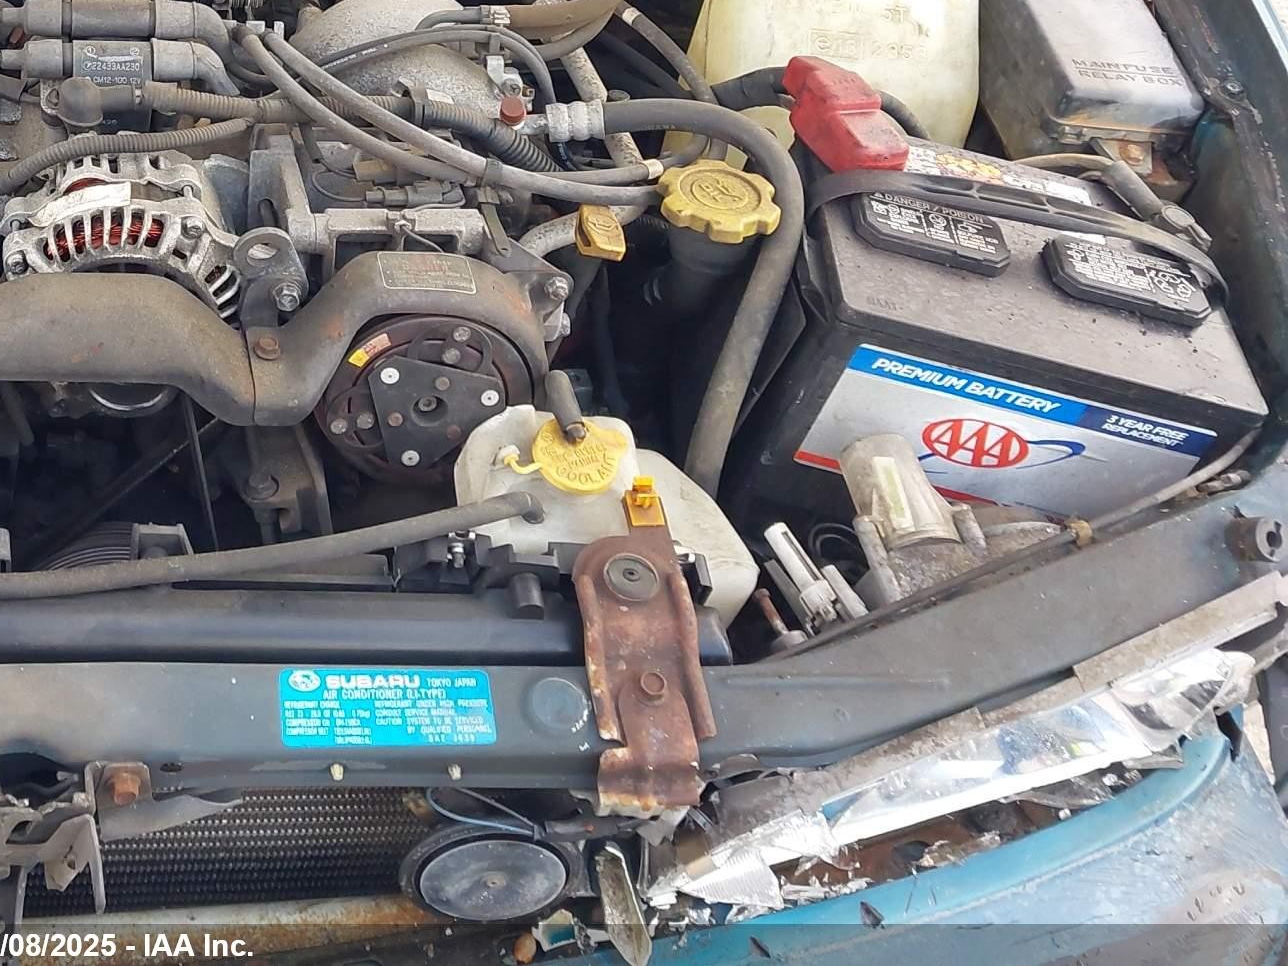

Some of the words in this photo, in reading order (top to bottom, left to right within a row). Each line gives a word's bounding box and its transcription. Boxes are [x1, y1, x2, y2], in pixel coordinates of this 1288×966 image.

[1072, 58, 1119, 70] MAIN
[1078, 69, 1136, 82] RELAY
[1143, 75, 1184, 86] BOX
[885, 193, 930, 211] DANGER
[942, 206, 984, 224] POISON
[872, 357, 968, 391] PREMIUM
[964, 381, 1062, 413] BATTERY
[1101, 422, 1184, 447] REPLACEMENT
[1106, 414, 1116, 424] 3
[1116, 417, 1154, 434] YEAR
[1152, 426, 1189, 442] FREE
[931, 419, 1014, 467] AAA
[325, 674, 420, 689] SUBARU
[427, 678, 452, 687] TOKYO
[454, 678, 477, 687] JAPAN
[323, 690, 338, 699] AIR
[341, 690, 403, 699] CONDITIONER
